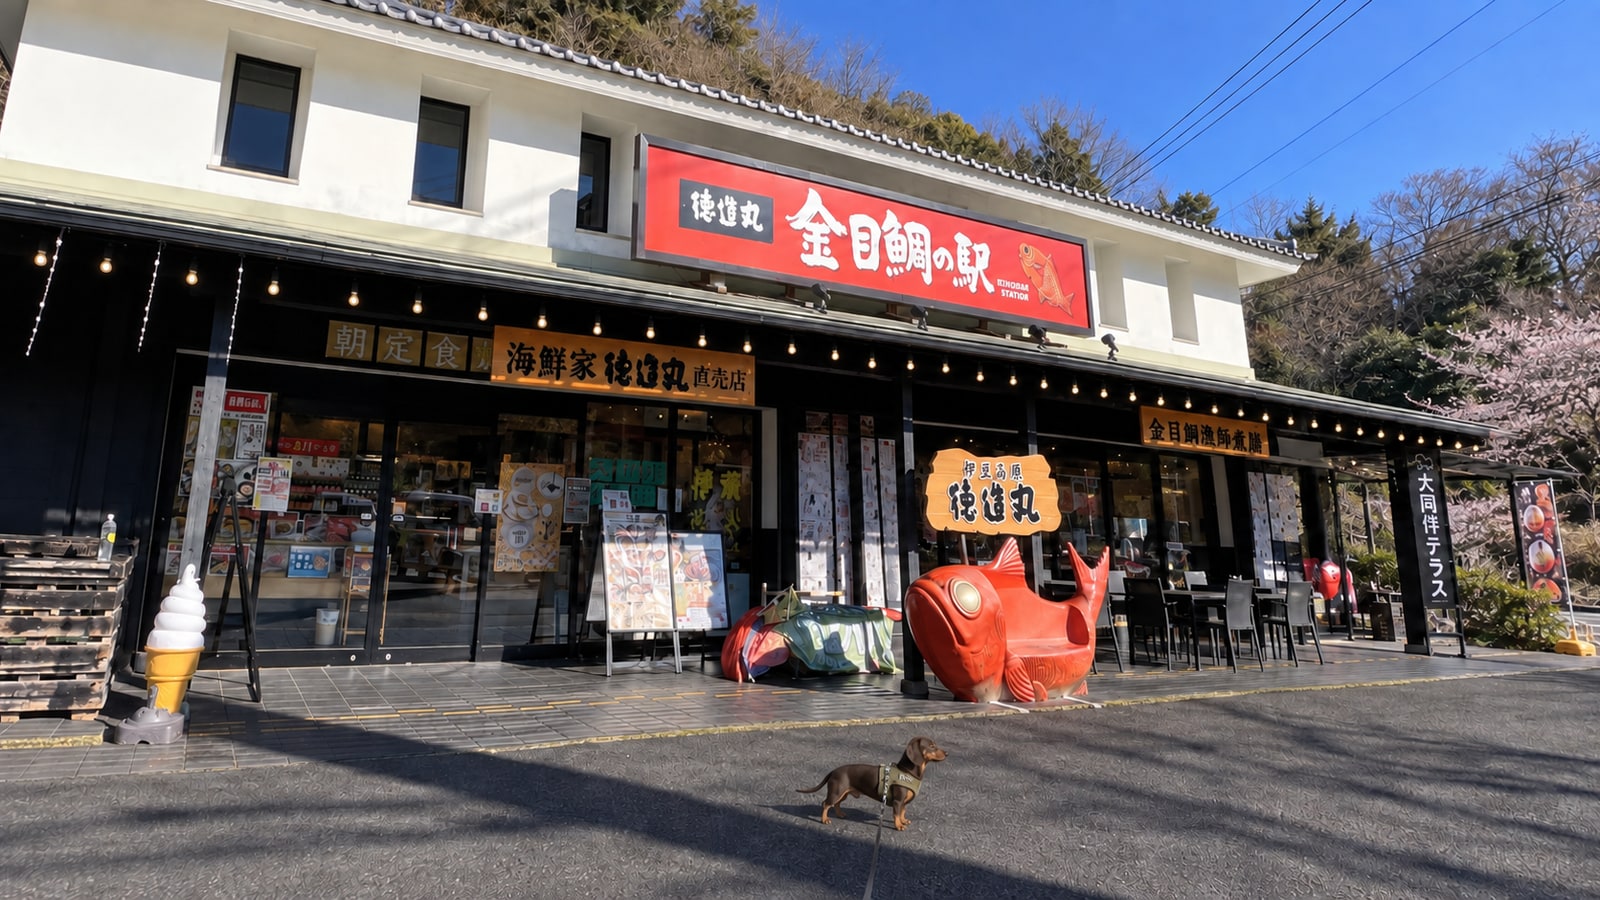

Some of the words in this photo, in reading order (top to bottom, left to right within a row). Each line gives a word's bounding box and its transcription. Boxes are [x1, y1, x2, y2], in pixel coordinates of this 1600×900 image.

[690, 187, 764, 232] 徳造丸
[785, 187, 996, 293] 金目鯛の駅
[963, 459, 1023, 481] 伊豆高原
[947, 478, 1041, 524] 徳造丸
